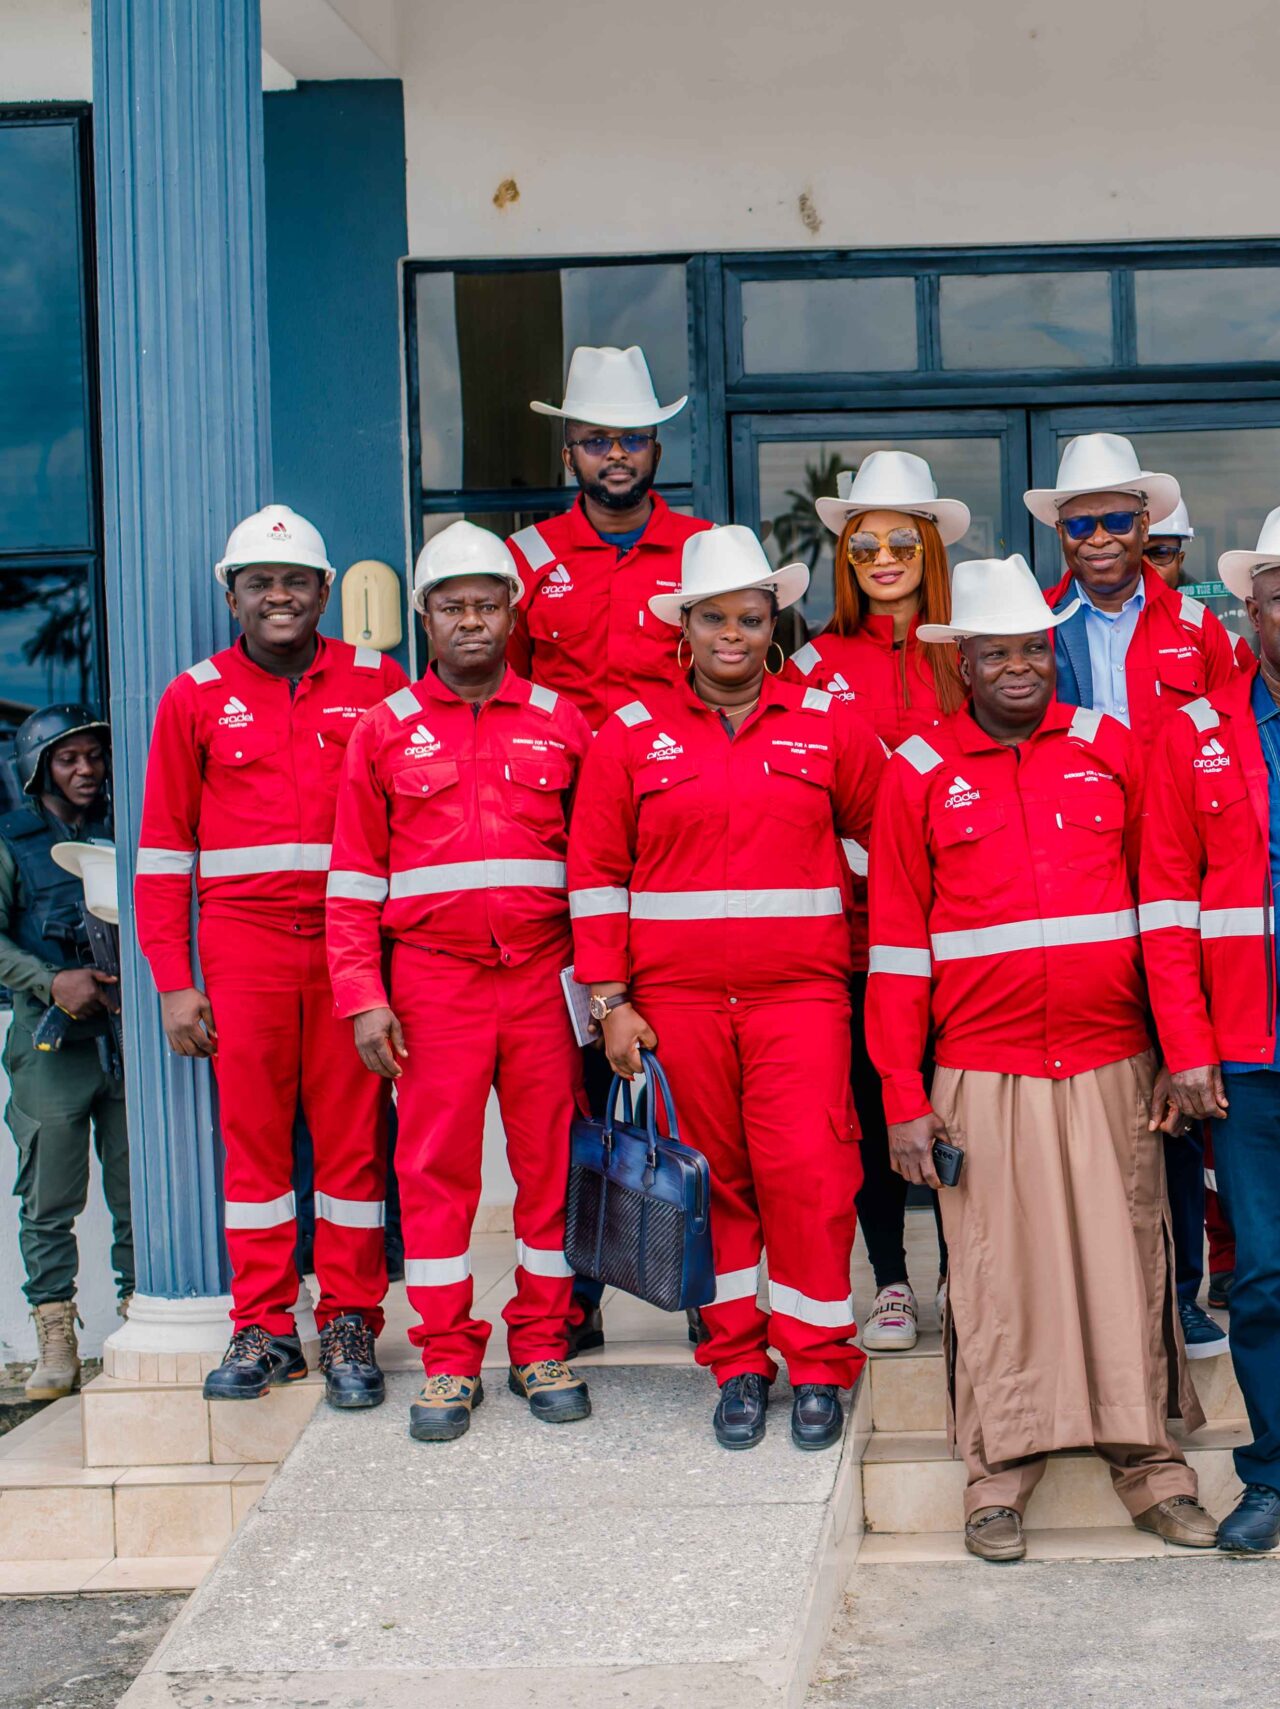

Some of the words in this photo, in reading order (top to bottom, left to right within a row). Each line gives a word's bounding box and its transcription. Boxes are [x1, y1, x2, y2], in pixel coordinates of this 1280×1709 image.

[541, 584, 573, 595] aradel
[218, 712, 254, 725] aradel
[404, 740, 441, 756] aradel
[646, 745, 684, 760] aradel
[1193, 755, 1230, 768] aradel
[944, 789, 980, 809] aradel
